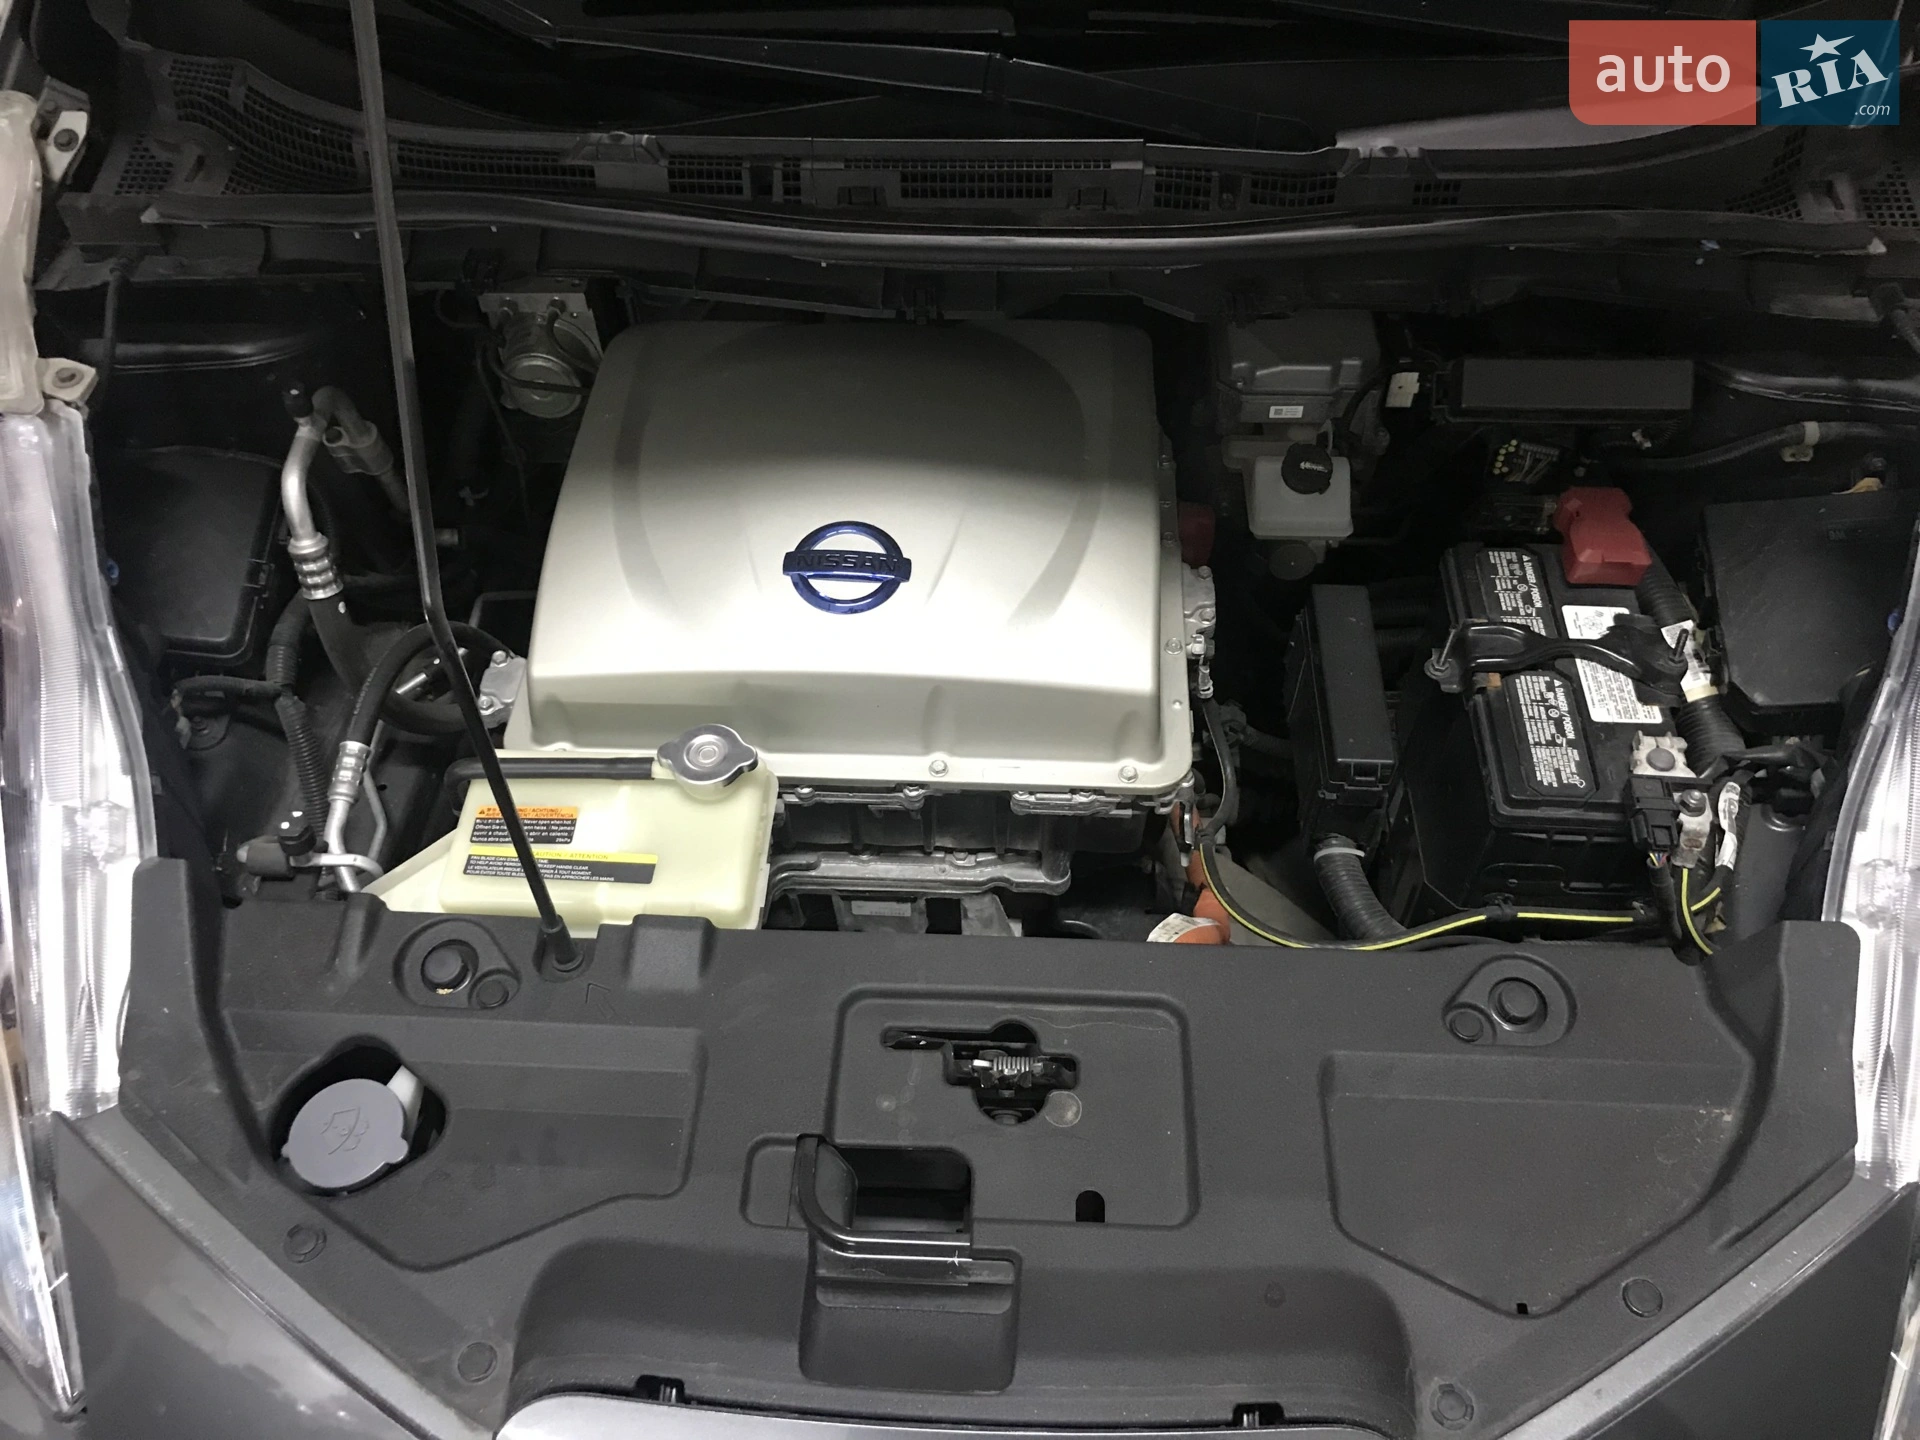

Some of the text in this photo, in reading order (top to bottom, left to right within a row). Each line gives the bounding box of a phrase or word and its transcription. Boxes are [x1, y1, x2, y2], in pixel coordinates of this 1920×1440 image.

[798, 553, 899, 571] NISSAN
[1523, 562, 1536, 583] DANGER
[1530, 588, 1543, 608] POISON
[1555, 687, 1569, 711] DANGER
[1562, 716, 1576, 739] POISON
